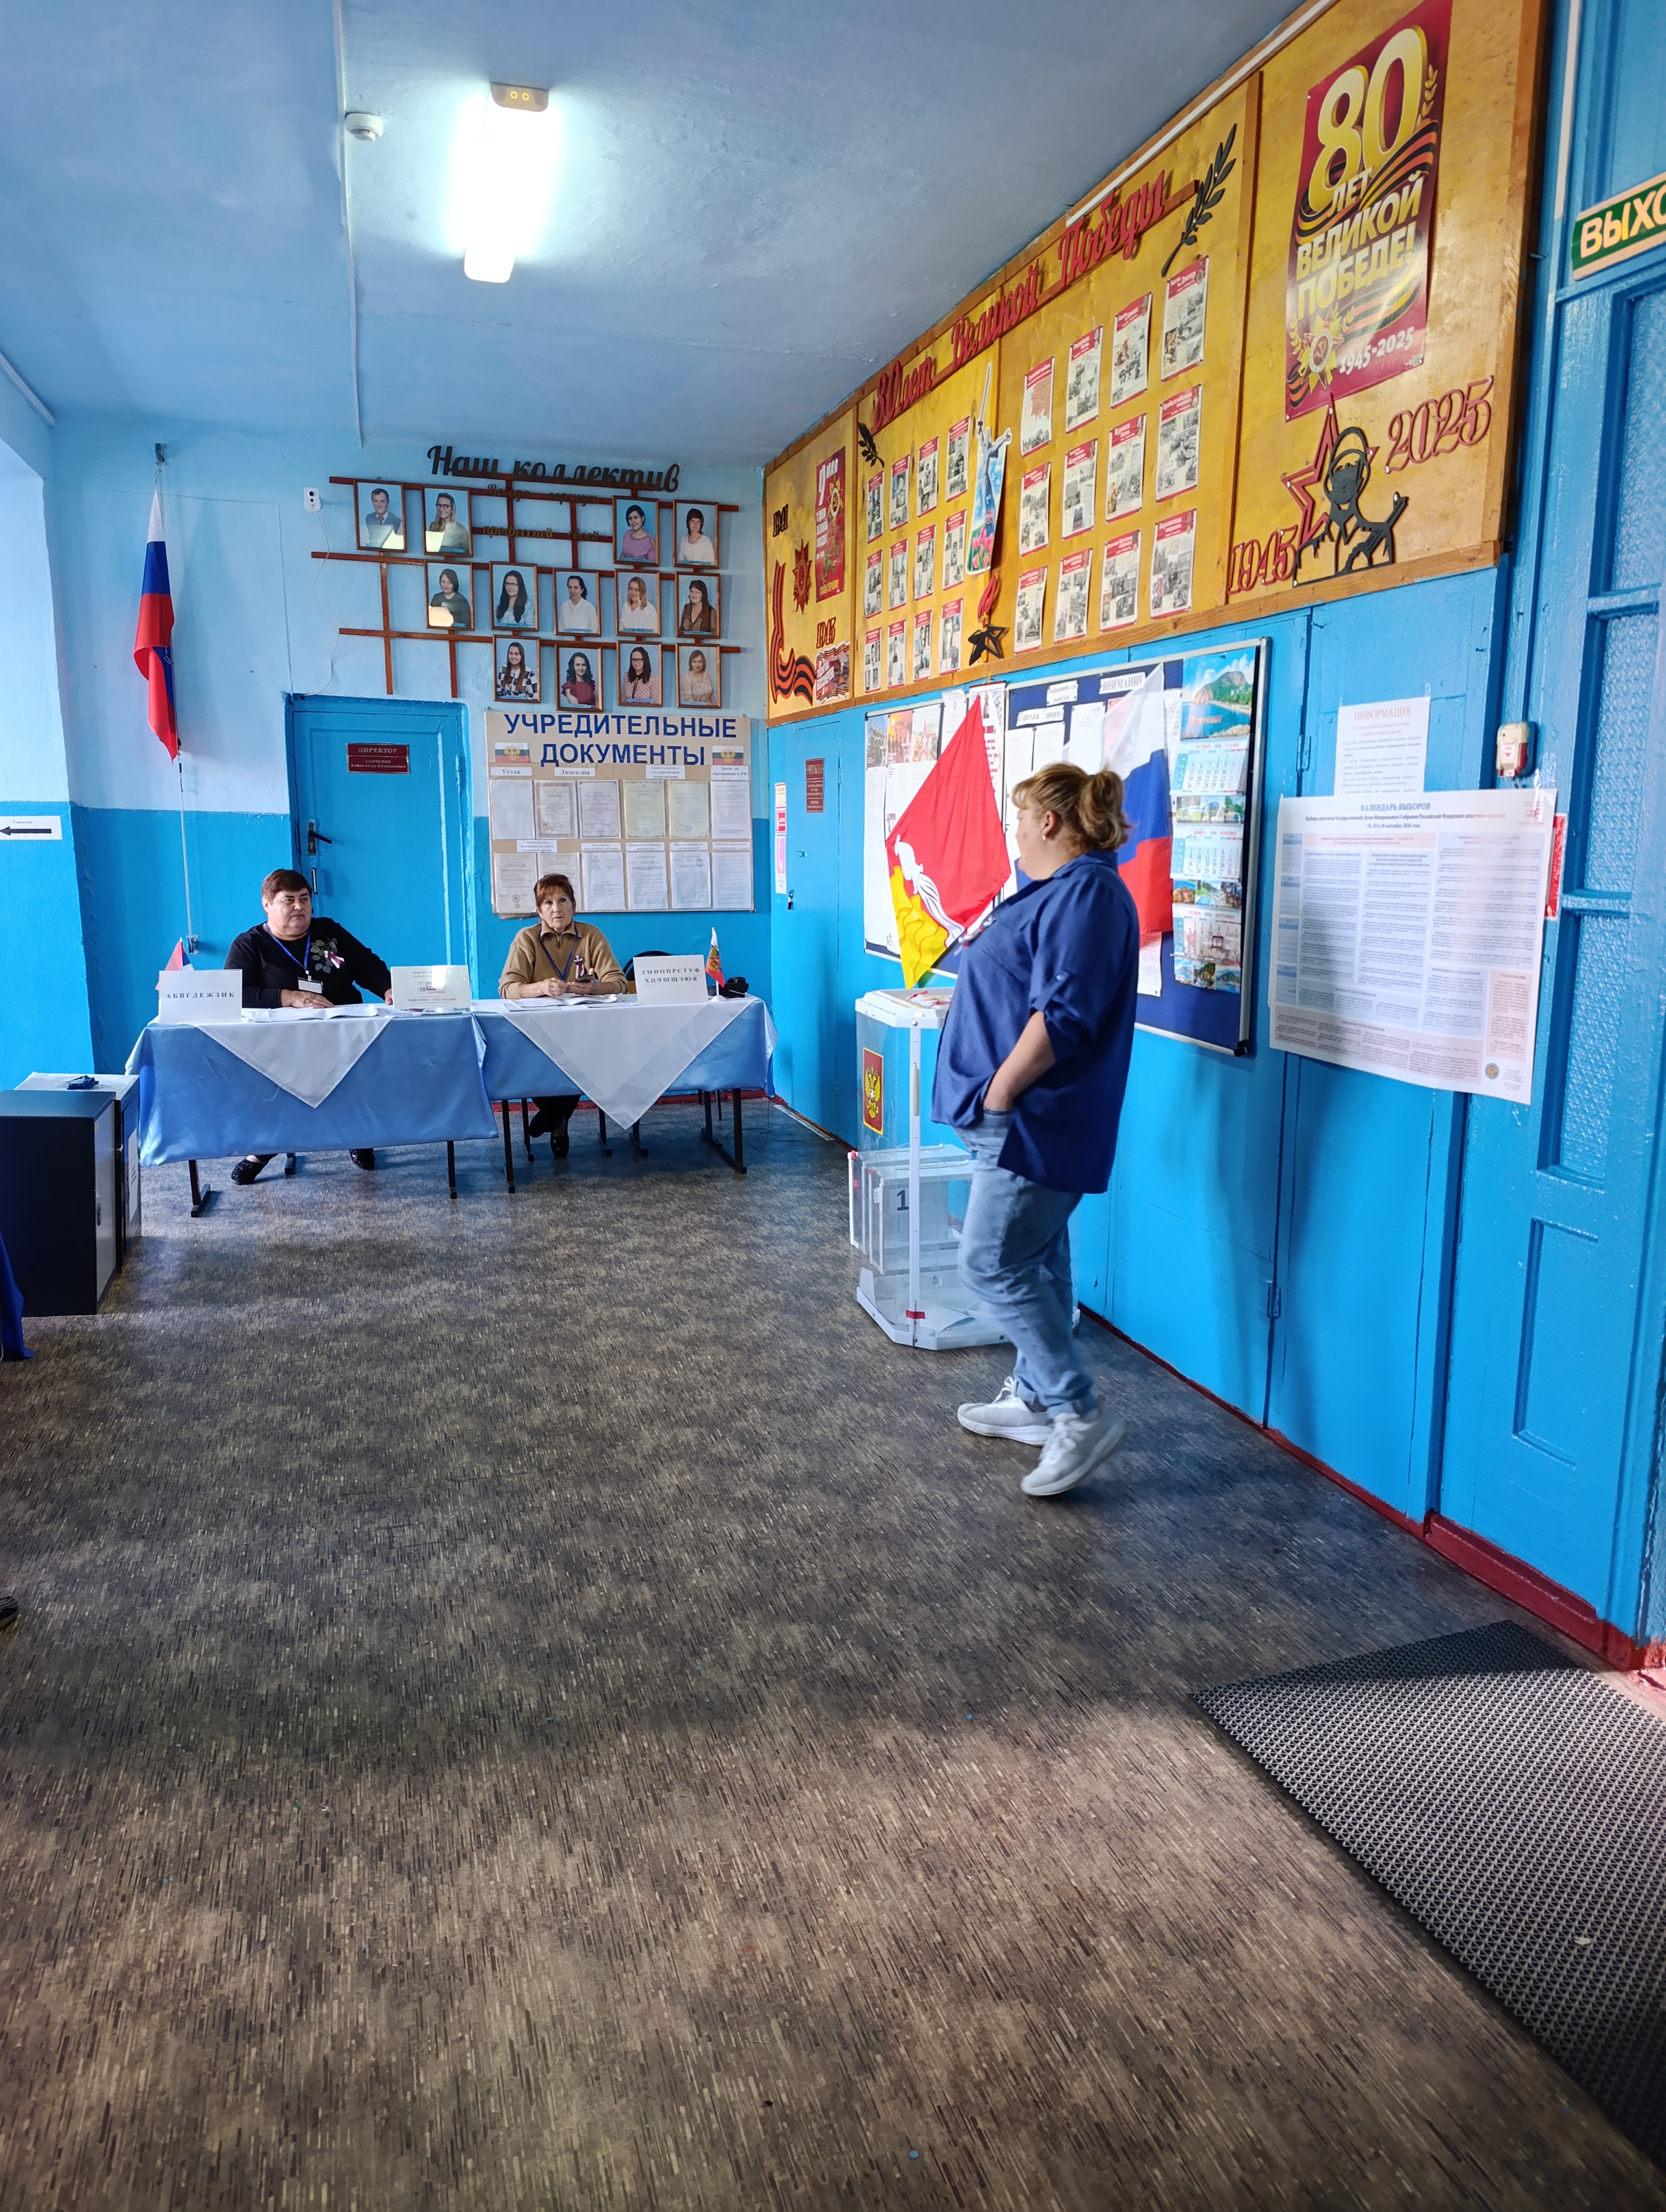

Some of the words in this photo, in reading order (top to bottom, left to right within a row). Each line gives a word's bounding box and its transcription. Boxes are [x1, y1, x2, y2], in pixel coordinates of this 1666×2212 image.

[1308, 25, 1427, 217] 80
[1327, 165, 1374, 217] ЛЕТ
[1296, 172, 1425, 281] ВЕЛИКОЙ
[1298, 221, 1417, 321] ПОБЕДЕ!
[874, 359, 902, 430] 80
[898, 356, 932, 409] лет
[951, 258, 1039, 368] Великой
[1058, 170, 1165, 287] Победы
[1339, 326, 1414, 375] 1945-2025
[1385, 375, 1494, 474] 2025
[427, 445, 499, 476] Наш
[513, 458, 680, 492] коллектив
[818, 464, 826, 506] 9
[1227, 525, 1298, 594] 1945
[504, 714, 736, 738] УЧРЕДИТЕЛЬНЫЕ
[1354, 706, 1411, 721] ИНФОРМАЦИЯ
[541, 744, 704, 767] ДОКУМЕНТЫ
[1361, 803, 1398, 812] КАЛЕНДАРЬ
[1399, 802, 1431, 811] ВЫБОРОВ
[896, 1189, 909, 1211] 1
